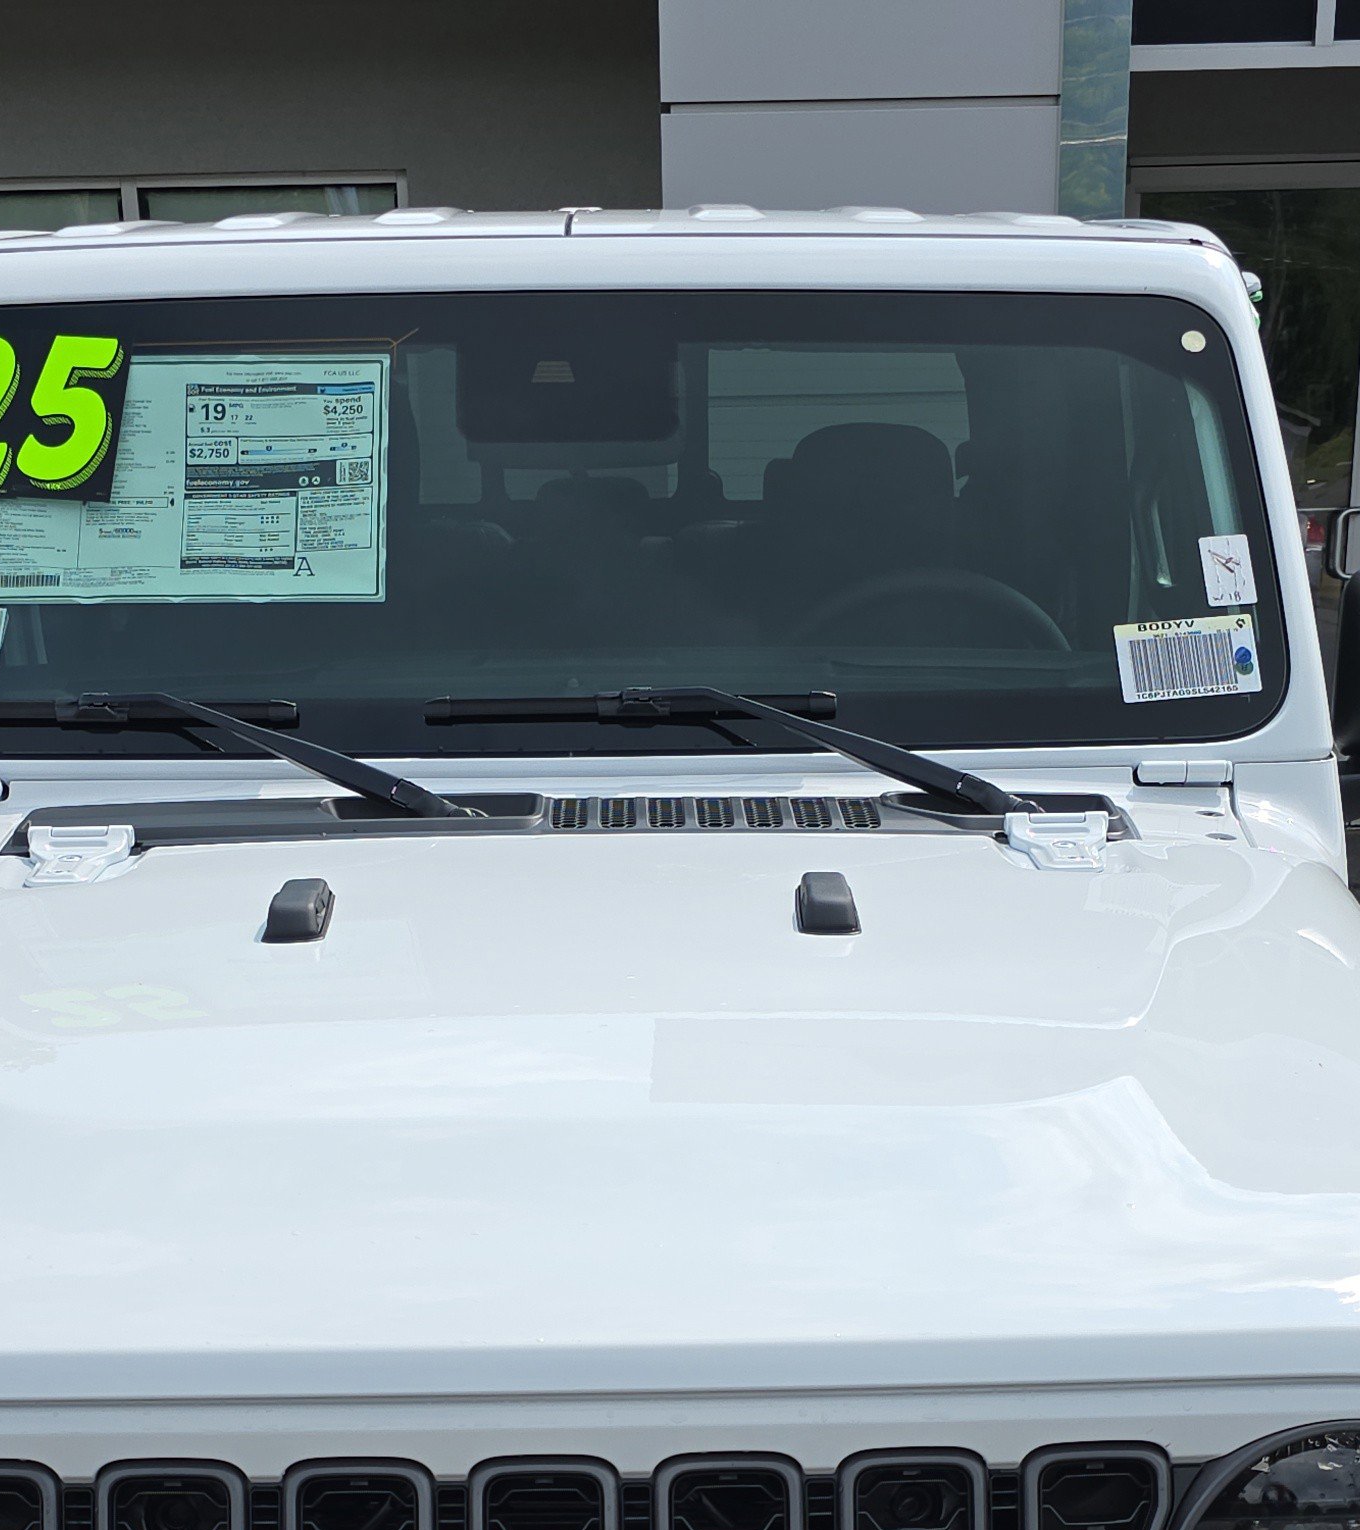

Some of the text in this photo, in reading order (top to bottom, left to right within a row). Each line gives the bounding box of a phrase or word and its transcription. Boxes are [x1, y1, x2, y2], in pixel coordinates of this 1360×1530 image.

[335, 396, 361, 405] spend
[201, 403, 226, 421] 19
[323, 404, 363, 416] $4,250
[189, 448, 230, 459] $2,750
[293, 557, 315, 577] A
[1137, 620, 1195, 632] BODYV
